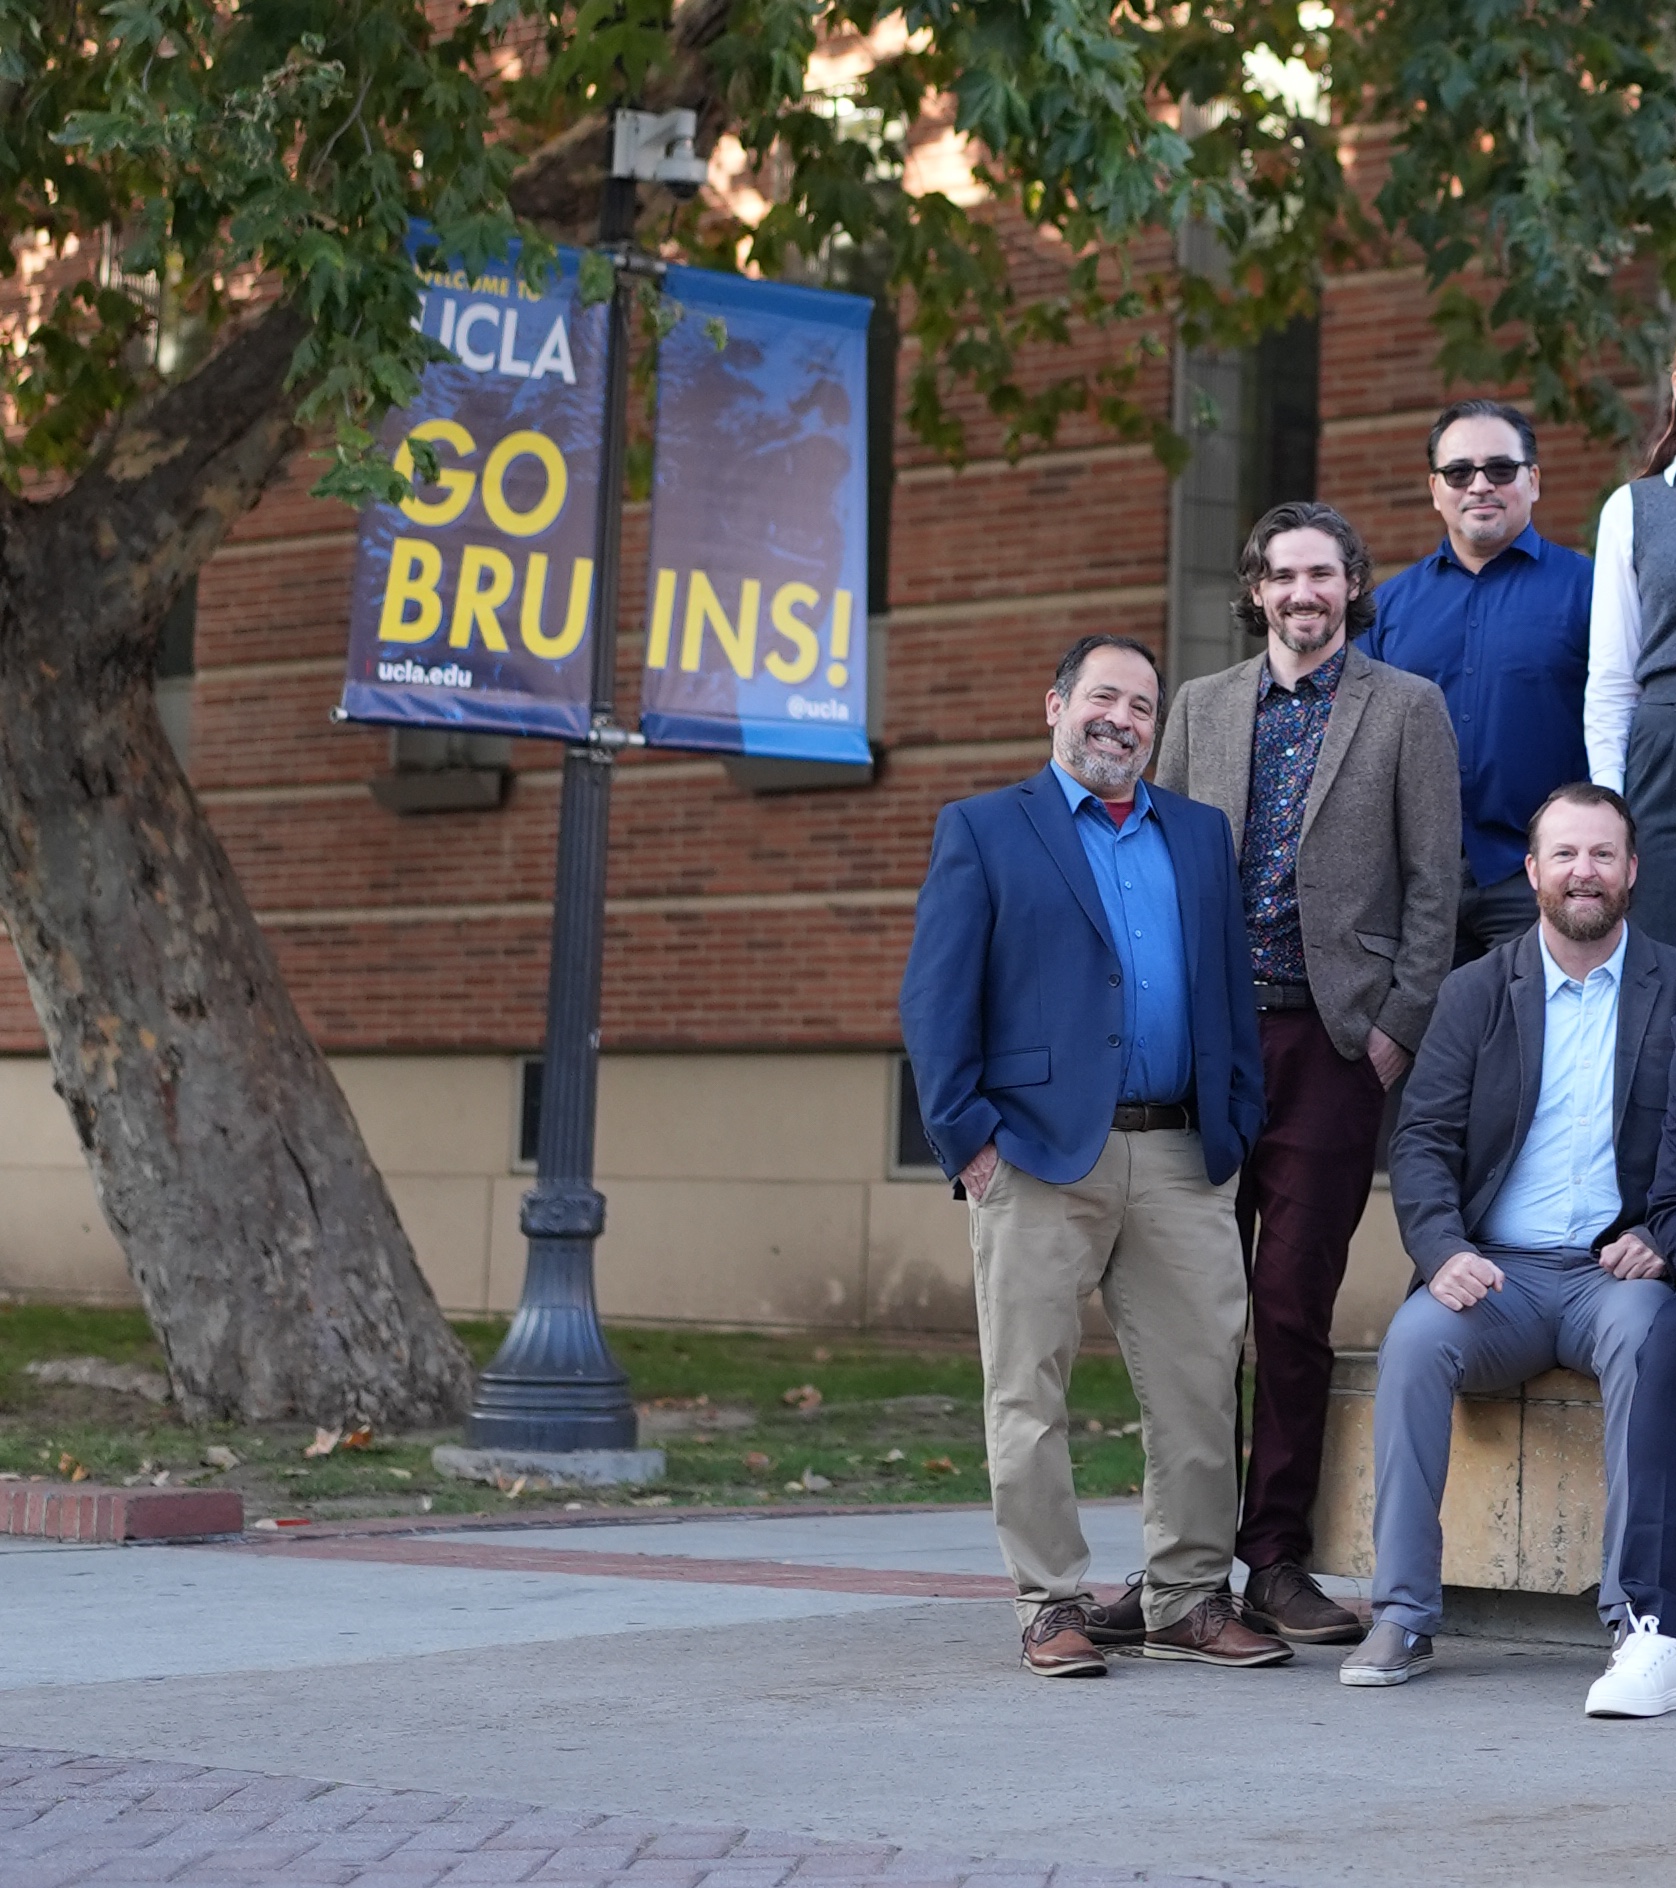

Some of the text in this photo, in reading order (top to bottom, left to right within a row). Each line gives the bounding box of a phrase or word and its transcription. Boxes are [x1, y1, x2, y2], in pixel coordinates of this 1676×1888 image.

[394, 418, 568, 538] GO
[378, 536, 594, 660] BRU
[647, 568, 853, 688] INS!
[377, 659, 473, 688] ucla.edu
[786, 694, 849, 721] @ucla
